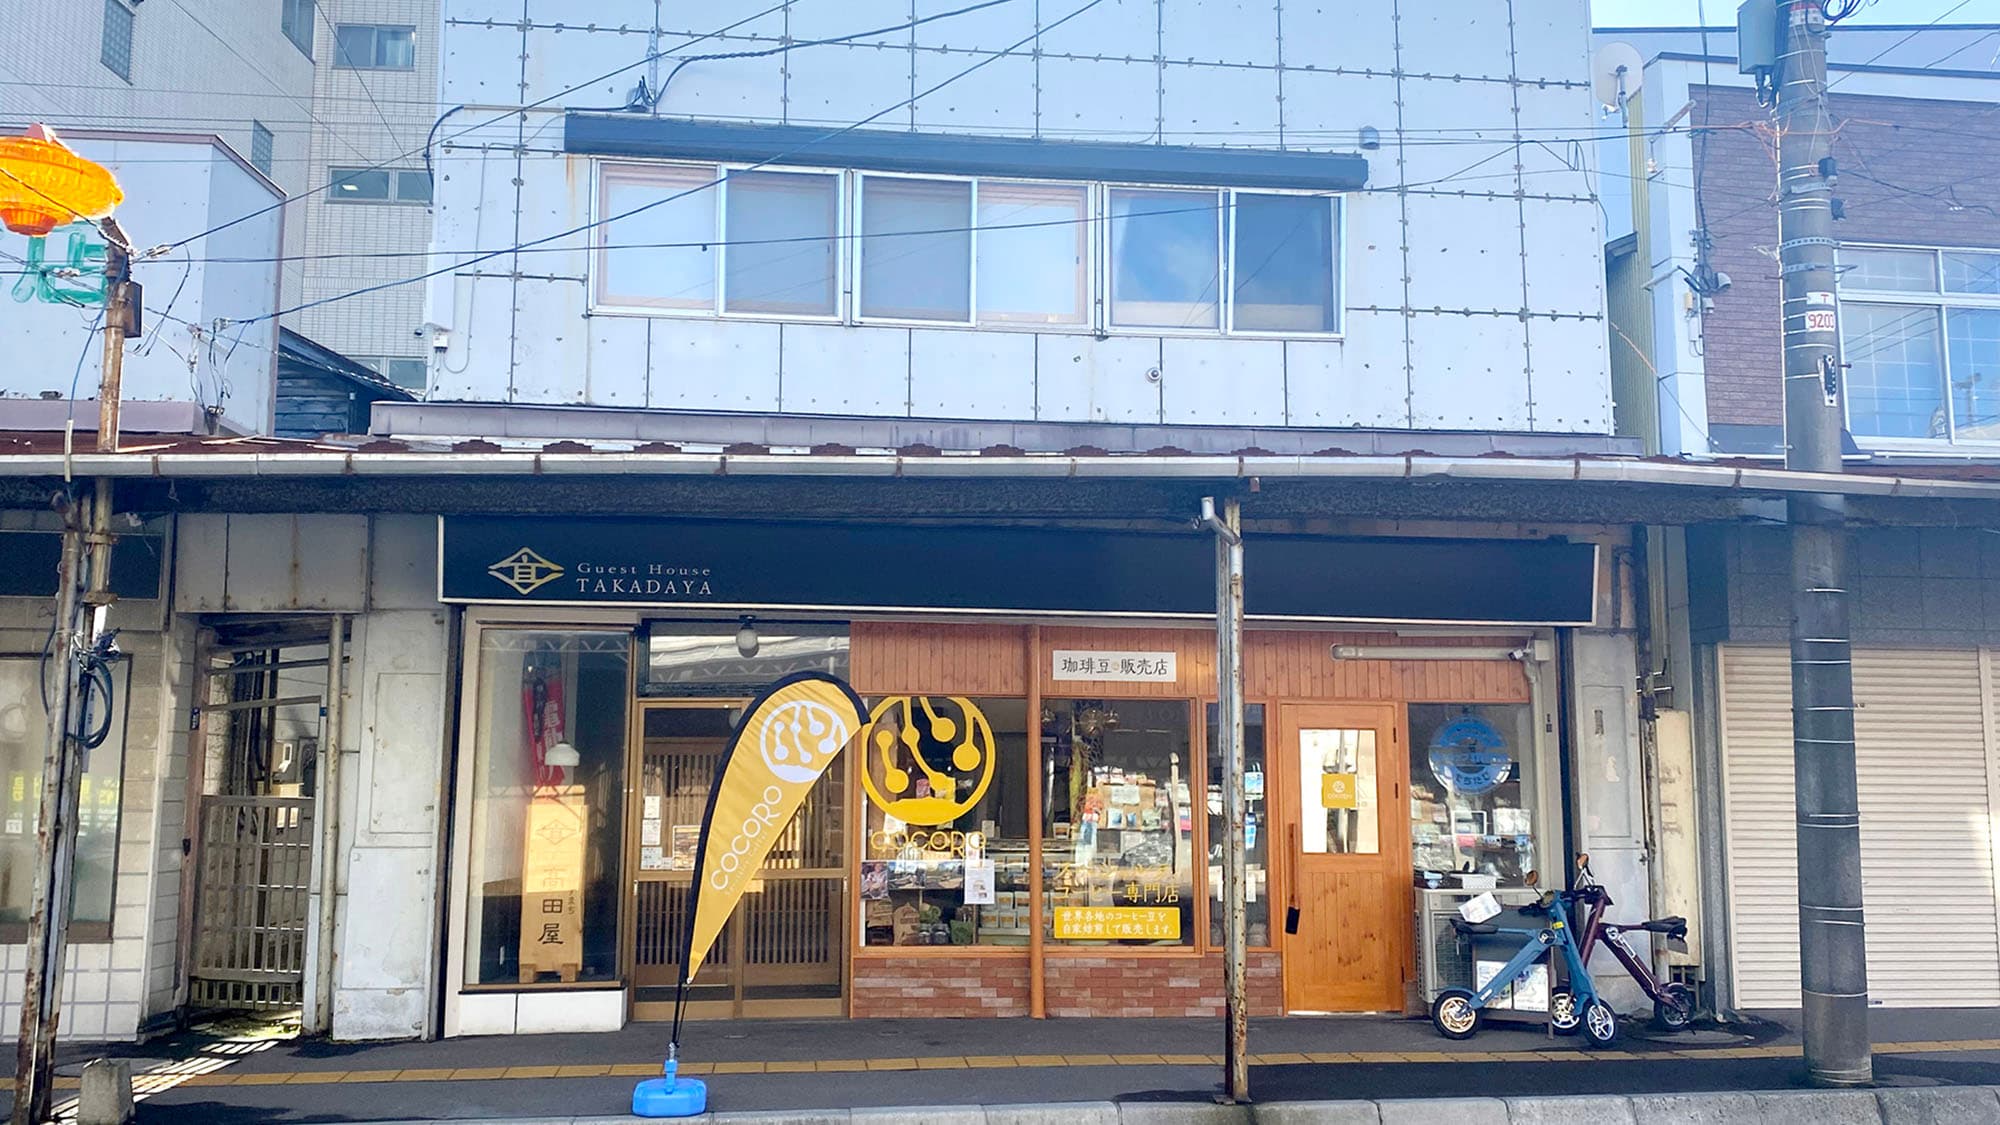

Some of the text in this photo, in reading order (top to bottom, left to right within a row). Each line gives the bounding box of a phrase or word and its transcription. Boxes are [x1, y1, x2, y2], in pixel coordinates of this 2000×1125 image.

[577, 562, 712, 576] Guest House
[576, 577, 713, 595] TAKADAYA
[1061, 657, 1169, 676] 珈琲豆 販売店
[710, 785, 782, 891] COCORO
[870, 830, 987, 858] COCORO
[1054, 882, 1180, 903] コーヒー専門店
[537, 866, 565, 945] 高田屋
[1062, 911, 1167, 922] 世界各地のコーヒー豆を
